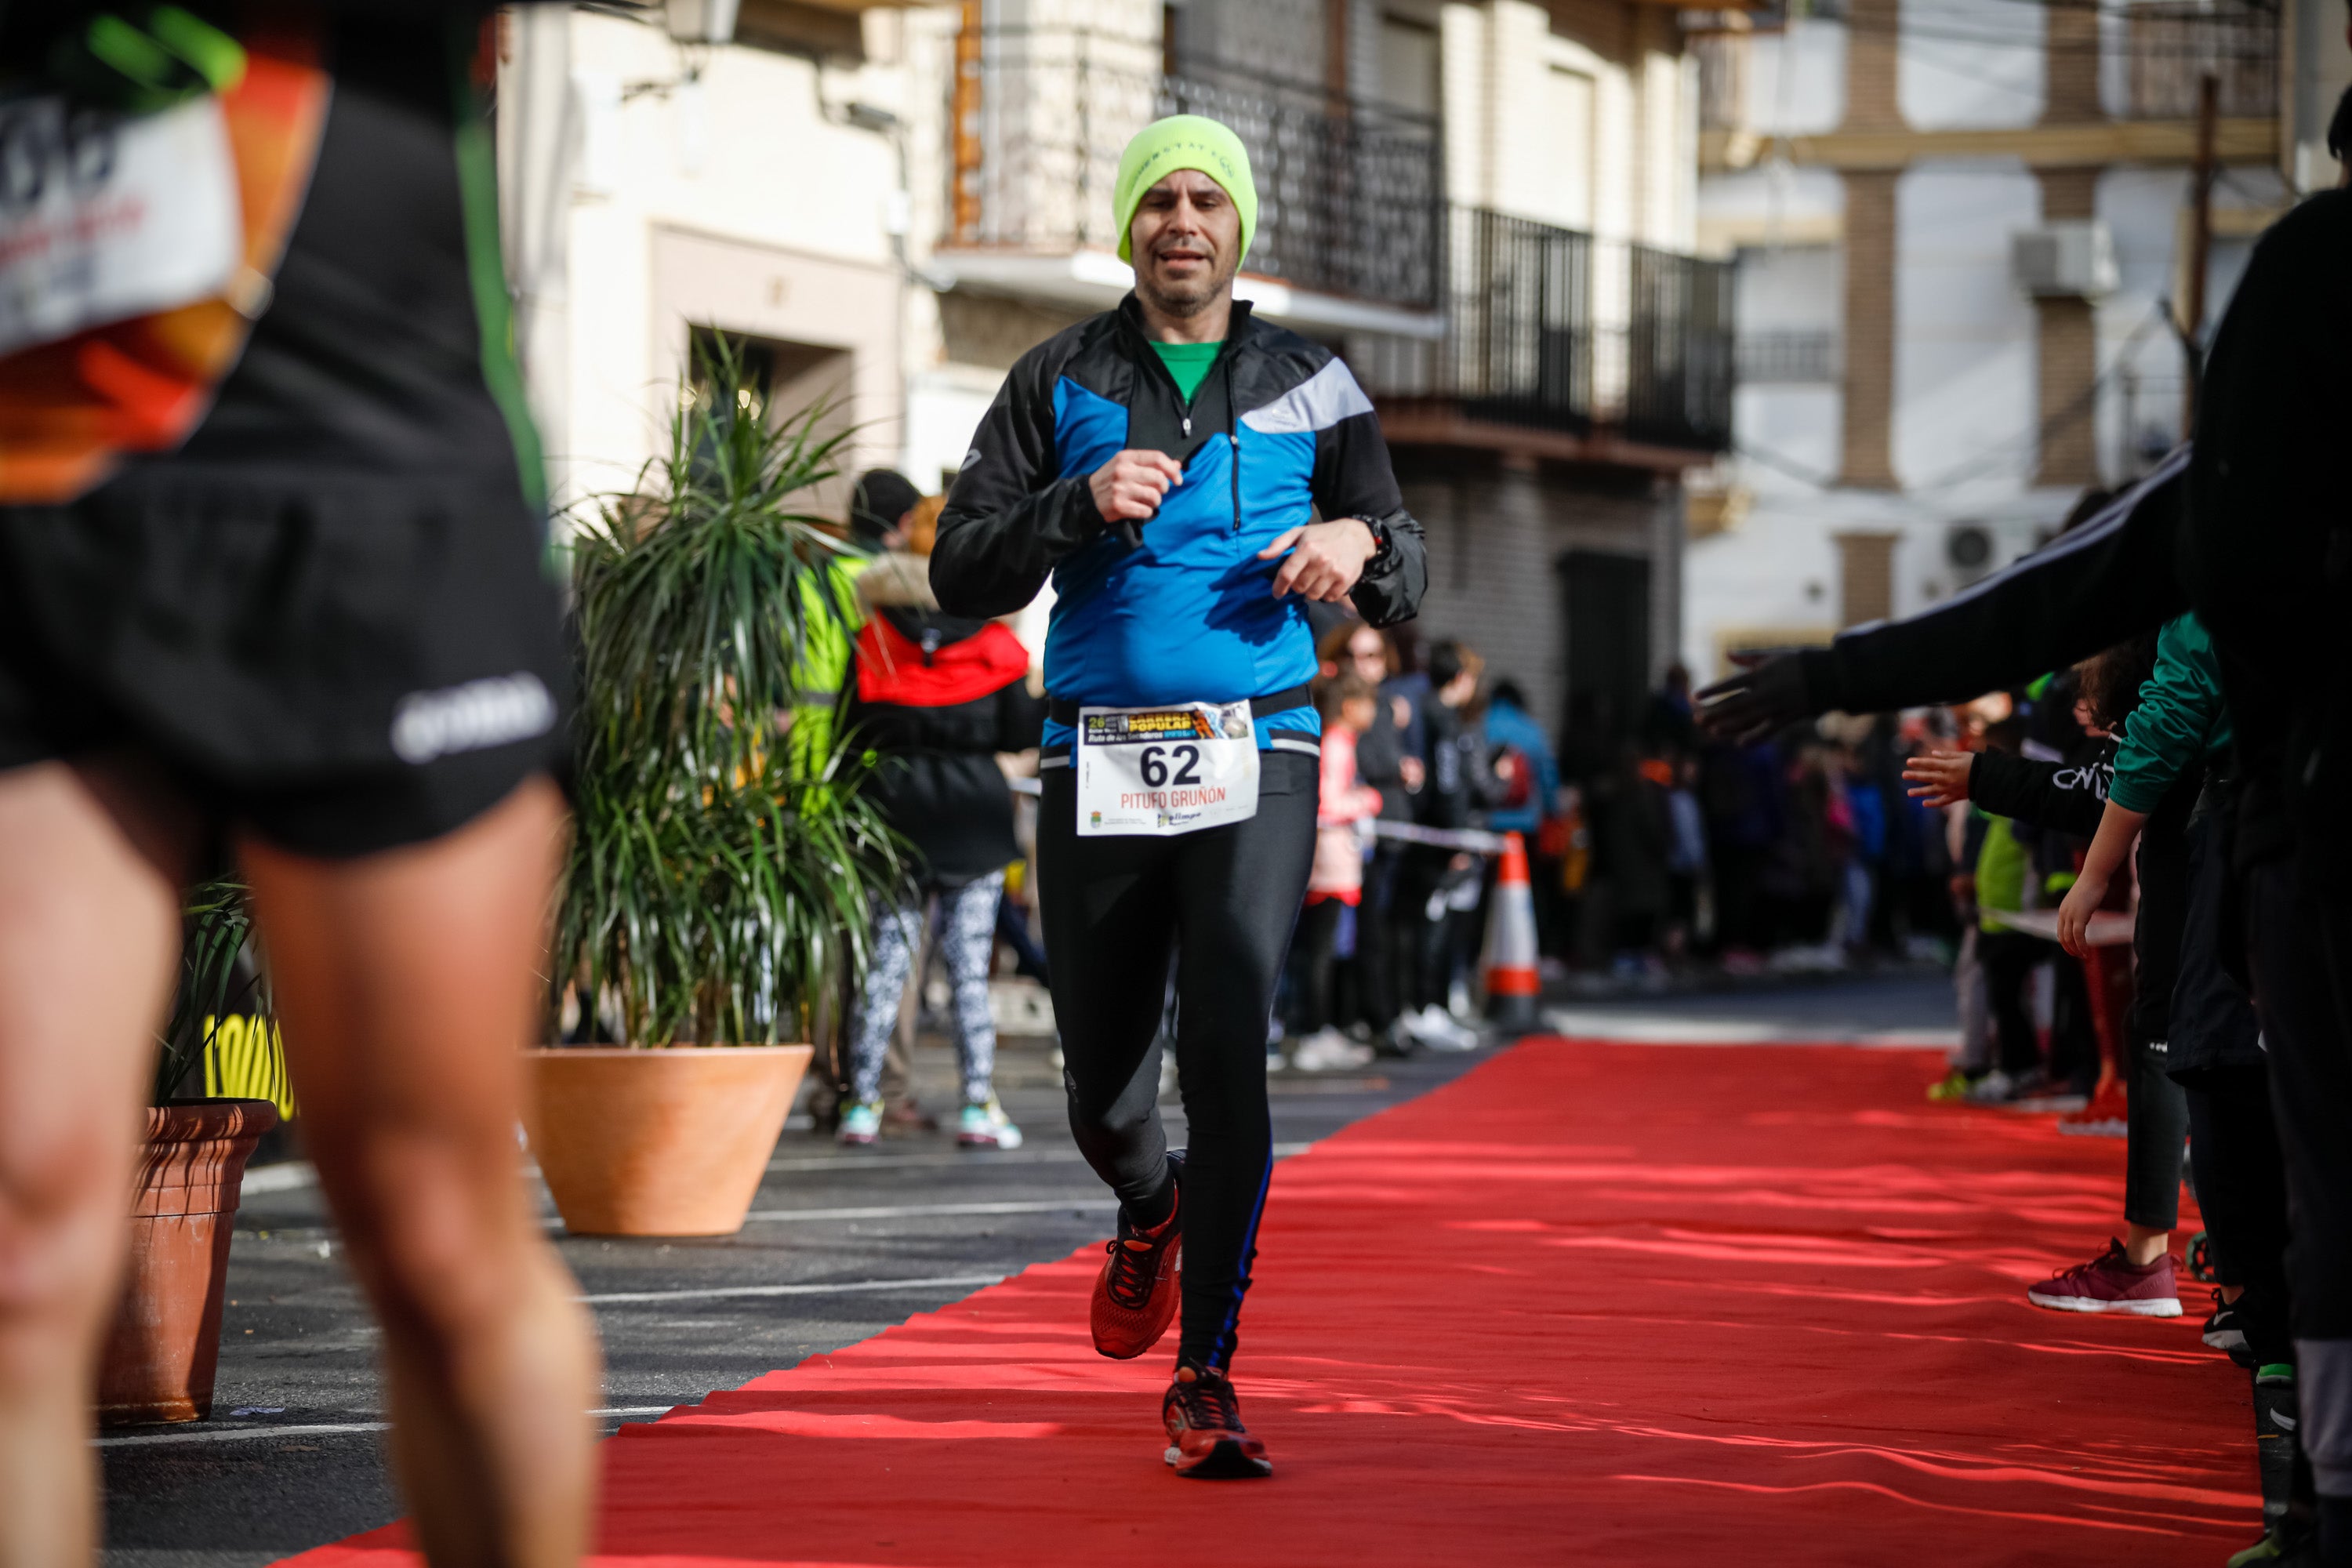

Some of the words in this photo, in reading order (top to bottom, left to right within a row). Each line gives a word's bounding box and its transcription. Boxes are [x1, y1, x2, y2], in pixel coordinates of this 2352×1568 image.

[1089, 717, 1105, 728] 26
[1129, 720, 1191, 732] POPULAR
[1088, 734, 1105, 742] Ruta
[1141, 745, 1201, 787] 62
[1121, 791, 1167, 809] PITUFO
[1171, 786, 1226, 808] GRUÑÓN
